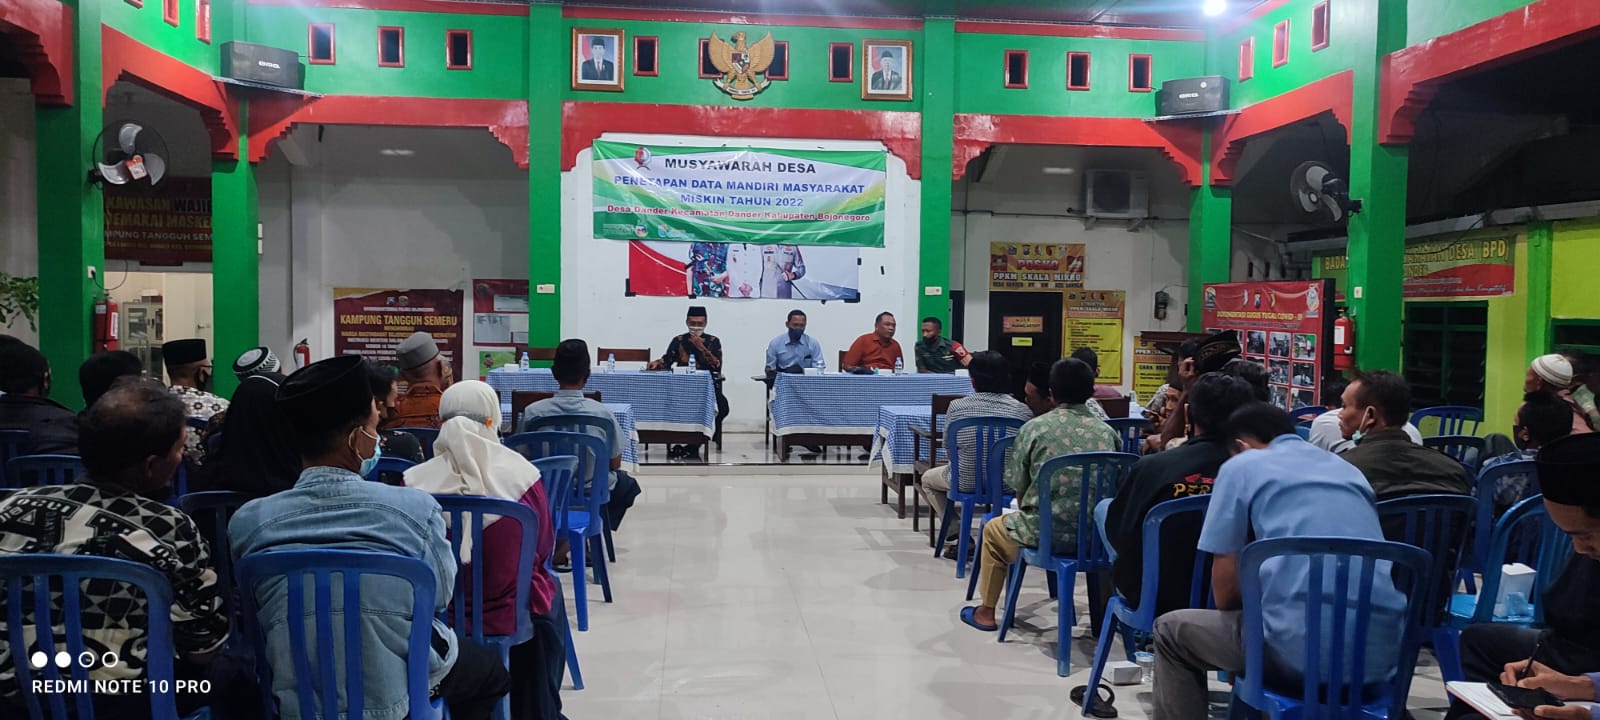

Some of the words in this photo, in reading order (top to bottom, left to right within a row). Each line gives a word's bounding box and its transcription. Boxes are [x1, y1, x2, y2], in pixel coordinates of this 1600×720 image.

[664, 158, 773, 172] MUSYAWARAH
[777, 162, 816, 174] DESA
[614, 175, 687, 188] PENETAPAN
[691, 179, 722, 190] DATA
[726, 181, 779, 192] MANDIRI
[782, 183, 865, 194] MASYARAKAT
[680, 194, 725, 205] MISKIN
[729, 195, 771, 206] TAHUN
[775, 198, 804, 207] 2022
[607, 205, 632, 213] Desa
[634, 206, 667, 214] Dander
[671, 207, 725, 217] Kecamatan
[728, 210, 761, 218] Dander
[764, 211, 815, 221] Kabupaten
[817, 212, 871, 222] Bojonegoro
[142, 231, 190, 241] TANGGUH
[1448, 242, 1475, 260] DESA
[993, 272, 1018, 281] PPKM
[1022, 272, 1050, 281] SKALA
[1054, 273, 1082, 281] MIKRO
[340, 314, 382, 325] KAMPUNG
[384, 315, 422, 326] TANGGUH
[423, 315, 457, 326] SEMERU
